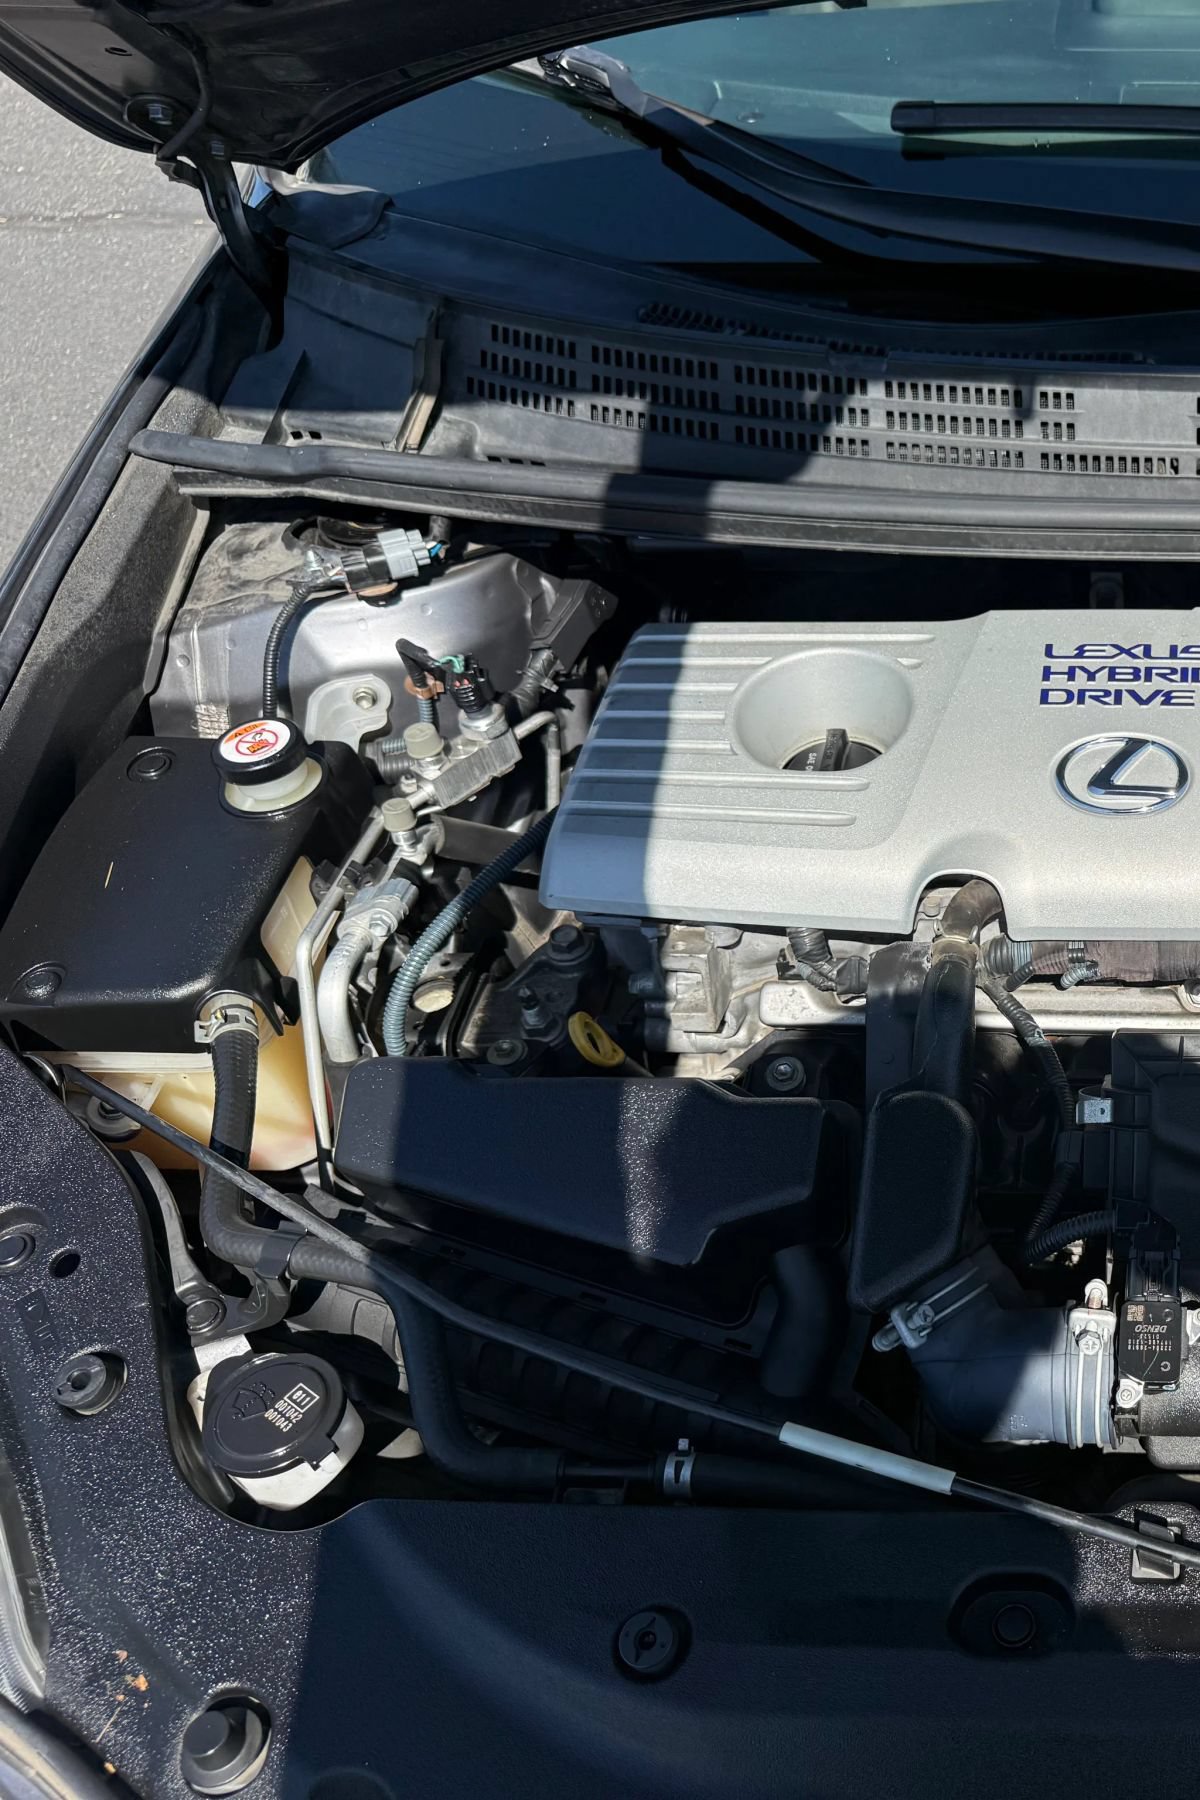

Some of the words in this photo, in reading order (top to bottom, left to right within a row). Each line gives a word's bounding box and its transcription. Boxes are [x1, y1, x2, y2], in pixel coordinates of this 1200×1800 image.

[1039, 688, 1196, 707] DRIVE
[1134, 1324, 1168, 1333] DENSO
[292, 1390, 311, 1406] e11
[264, 1408, 293, 1432] 001043
[274, 1399, 303, 1424] 001042
